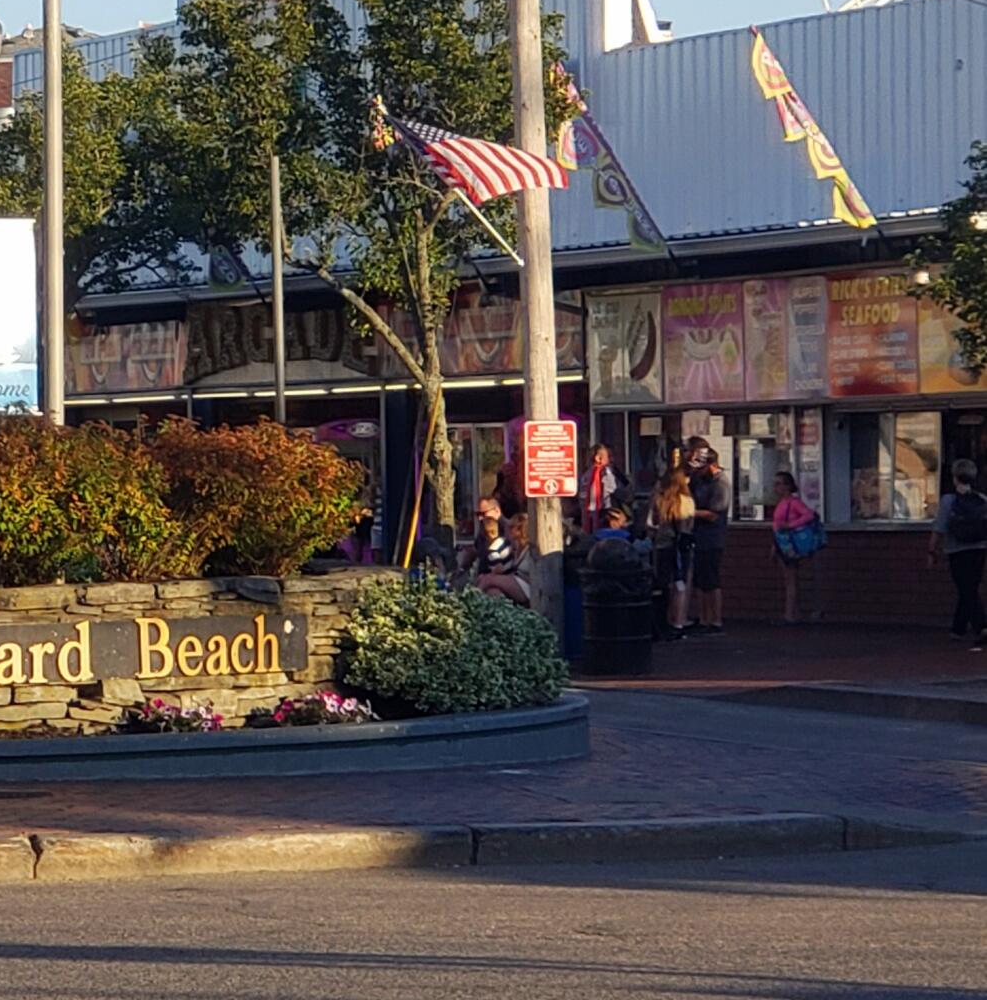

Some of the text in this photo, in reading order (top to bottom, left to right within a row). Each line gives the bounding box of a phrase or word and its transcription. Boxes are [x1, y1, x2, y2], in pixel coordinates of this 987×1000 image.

[831, 278, 870, 301] RICK'S
[875, 275, 912, 296] FRIE
[841, 302, 901, 327] SEAFOOD
[134, 614, 282, 679] Beach
